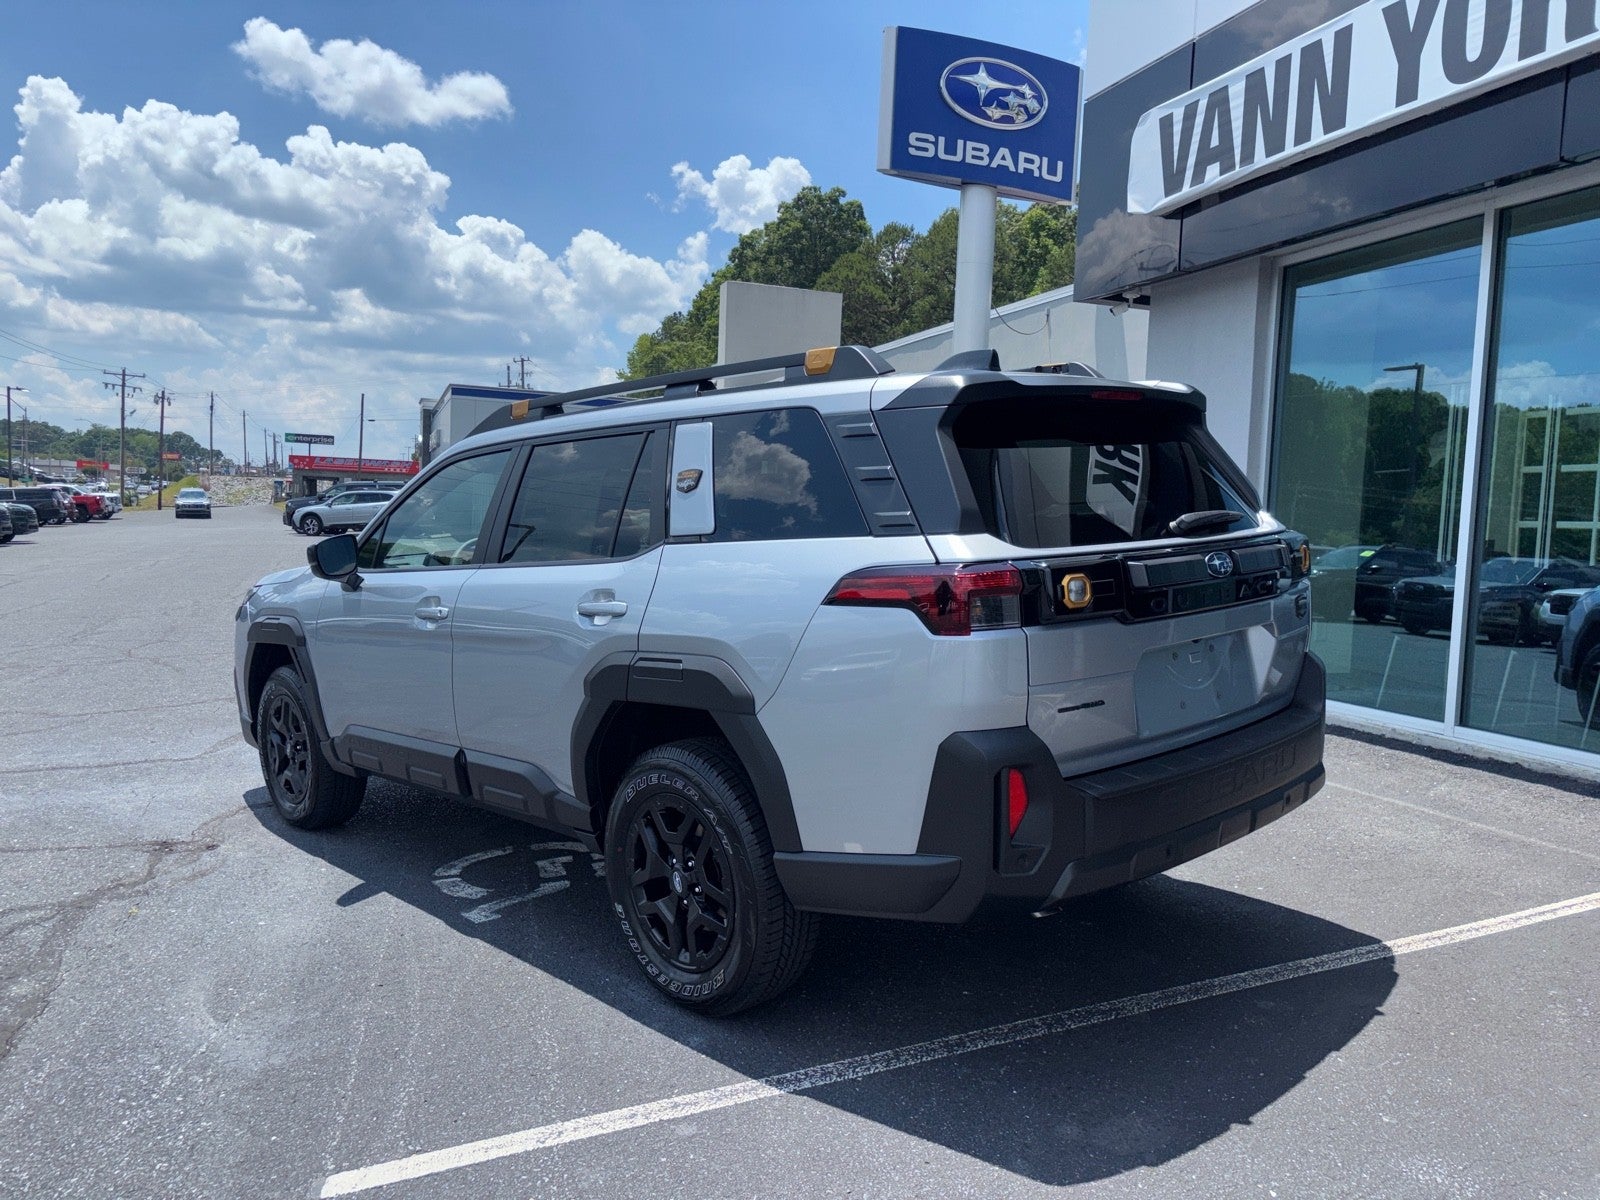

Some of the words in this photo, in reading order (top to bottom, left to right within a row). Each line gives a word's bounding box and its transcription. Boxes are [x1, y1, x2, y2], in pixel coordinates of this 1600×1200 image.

[1159, 23, 1353, 198] VANN
[908, 132, 1063, 183] SUBARU
[287, 434, 334, 443] enterprise
[625, 774, 700, 803] DUELER
